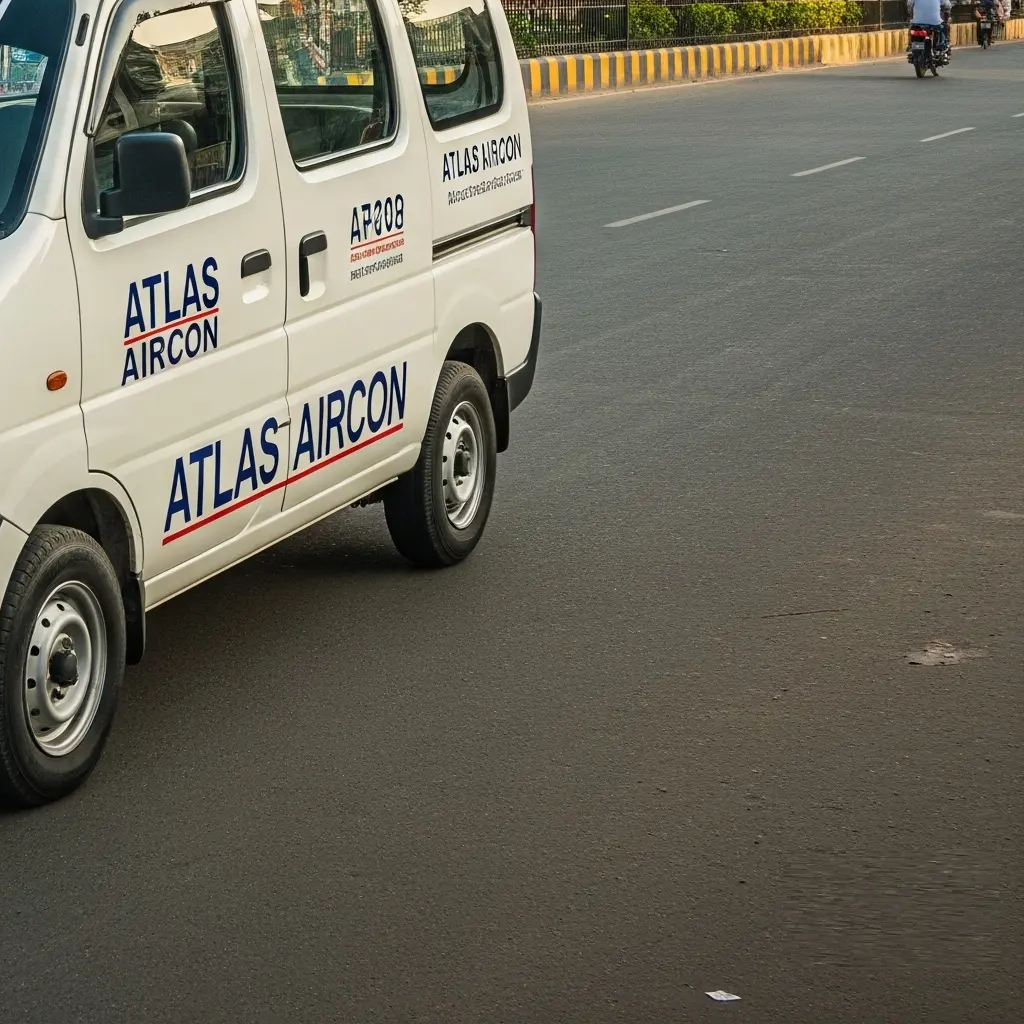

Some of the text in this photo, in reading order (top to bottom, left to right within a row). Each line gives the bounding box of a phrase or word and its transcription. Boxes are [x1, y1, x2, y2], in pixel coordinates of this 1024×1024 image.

[442, 145, 479, 182] ATLAS
[124, 256, 220, 338] ATLAS
[121, 316, 218, 386] AIRCON
[163, 361, 408, 533] ATLAS AIRCON
